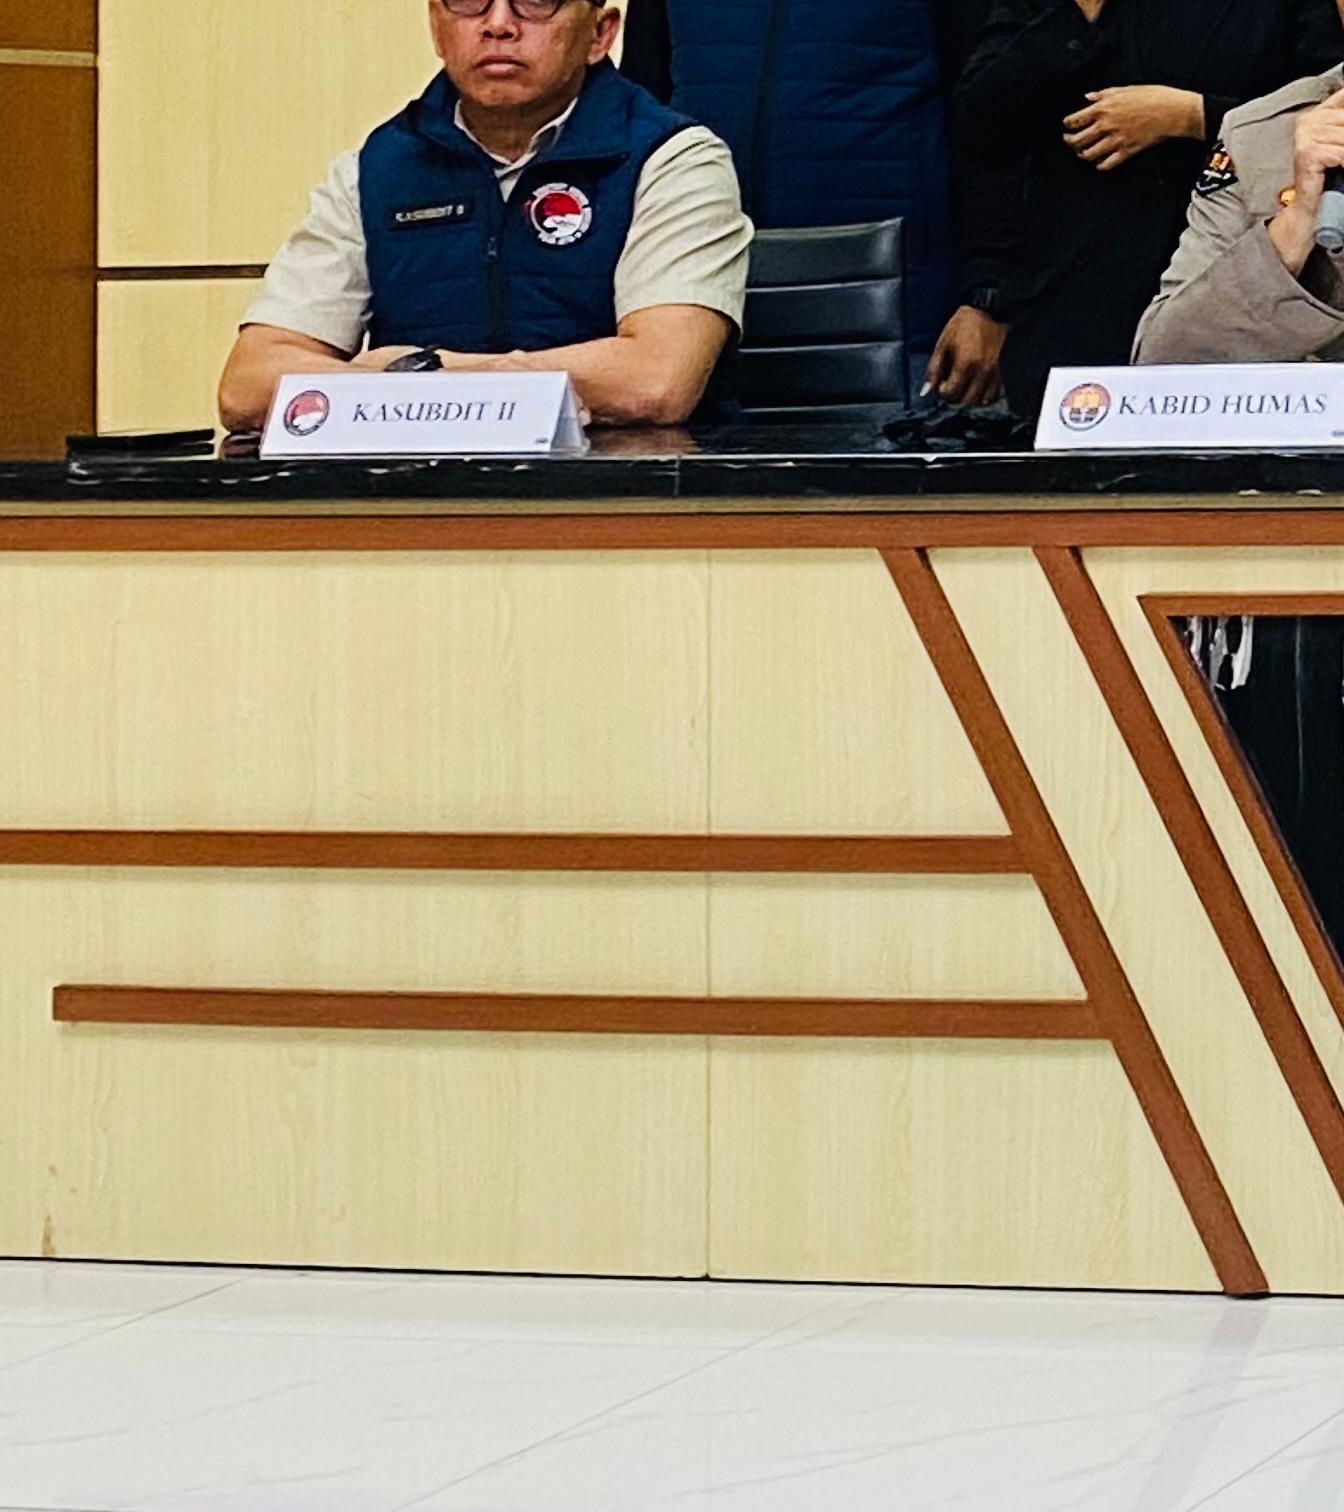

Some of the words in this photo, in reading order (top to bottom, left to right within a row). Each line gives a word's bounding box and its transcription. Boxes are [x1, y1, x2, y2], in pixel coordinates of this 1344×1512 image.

[352, 401, 491, 422] KASUBDIT
[497, 401, 517, 421] II
[1119, 394, 1212, 416] KABID
[1221, 392, 1328, 415] HUMAS
